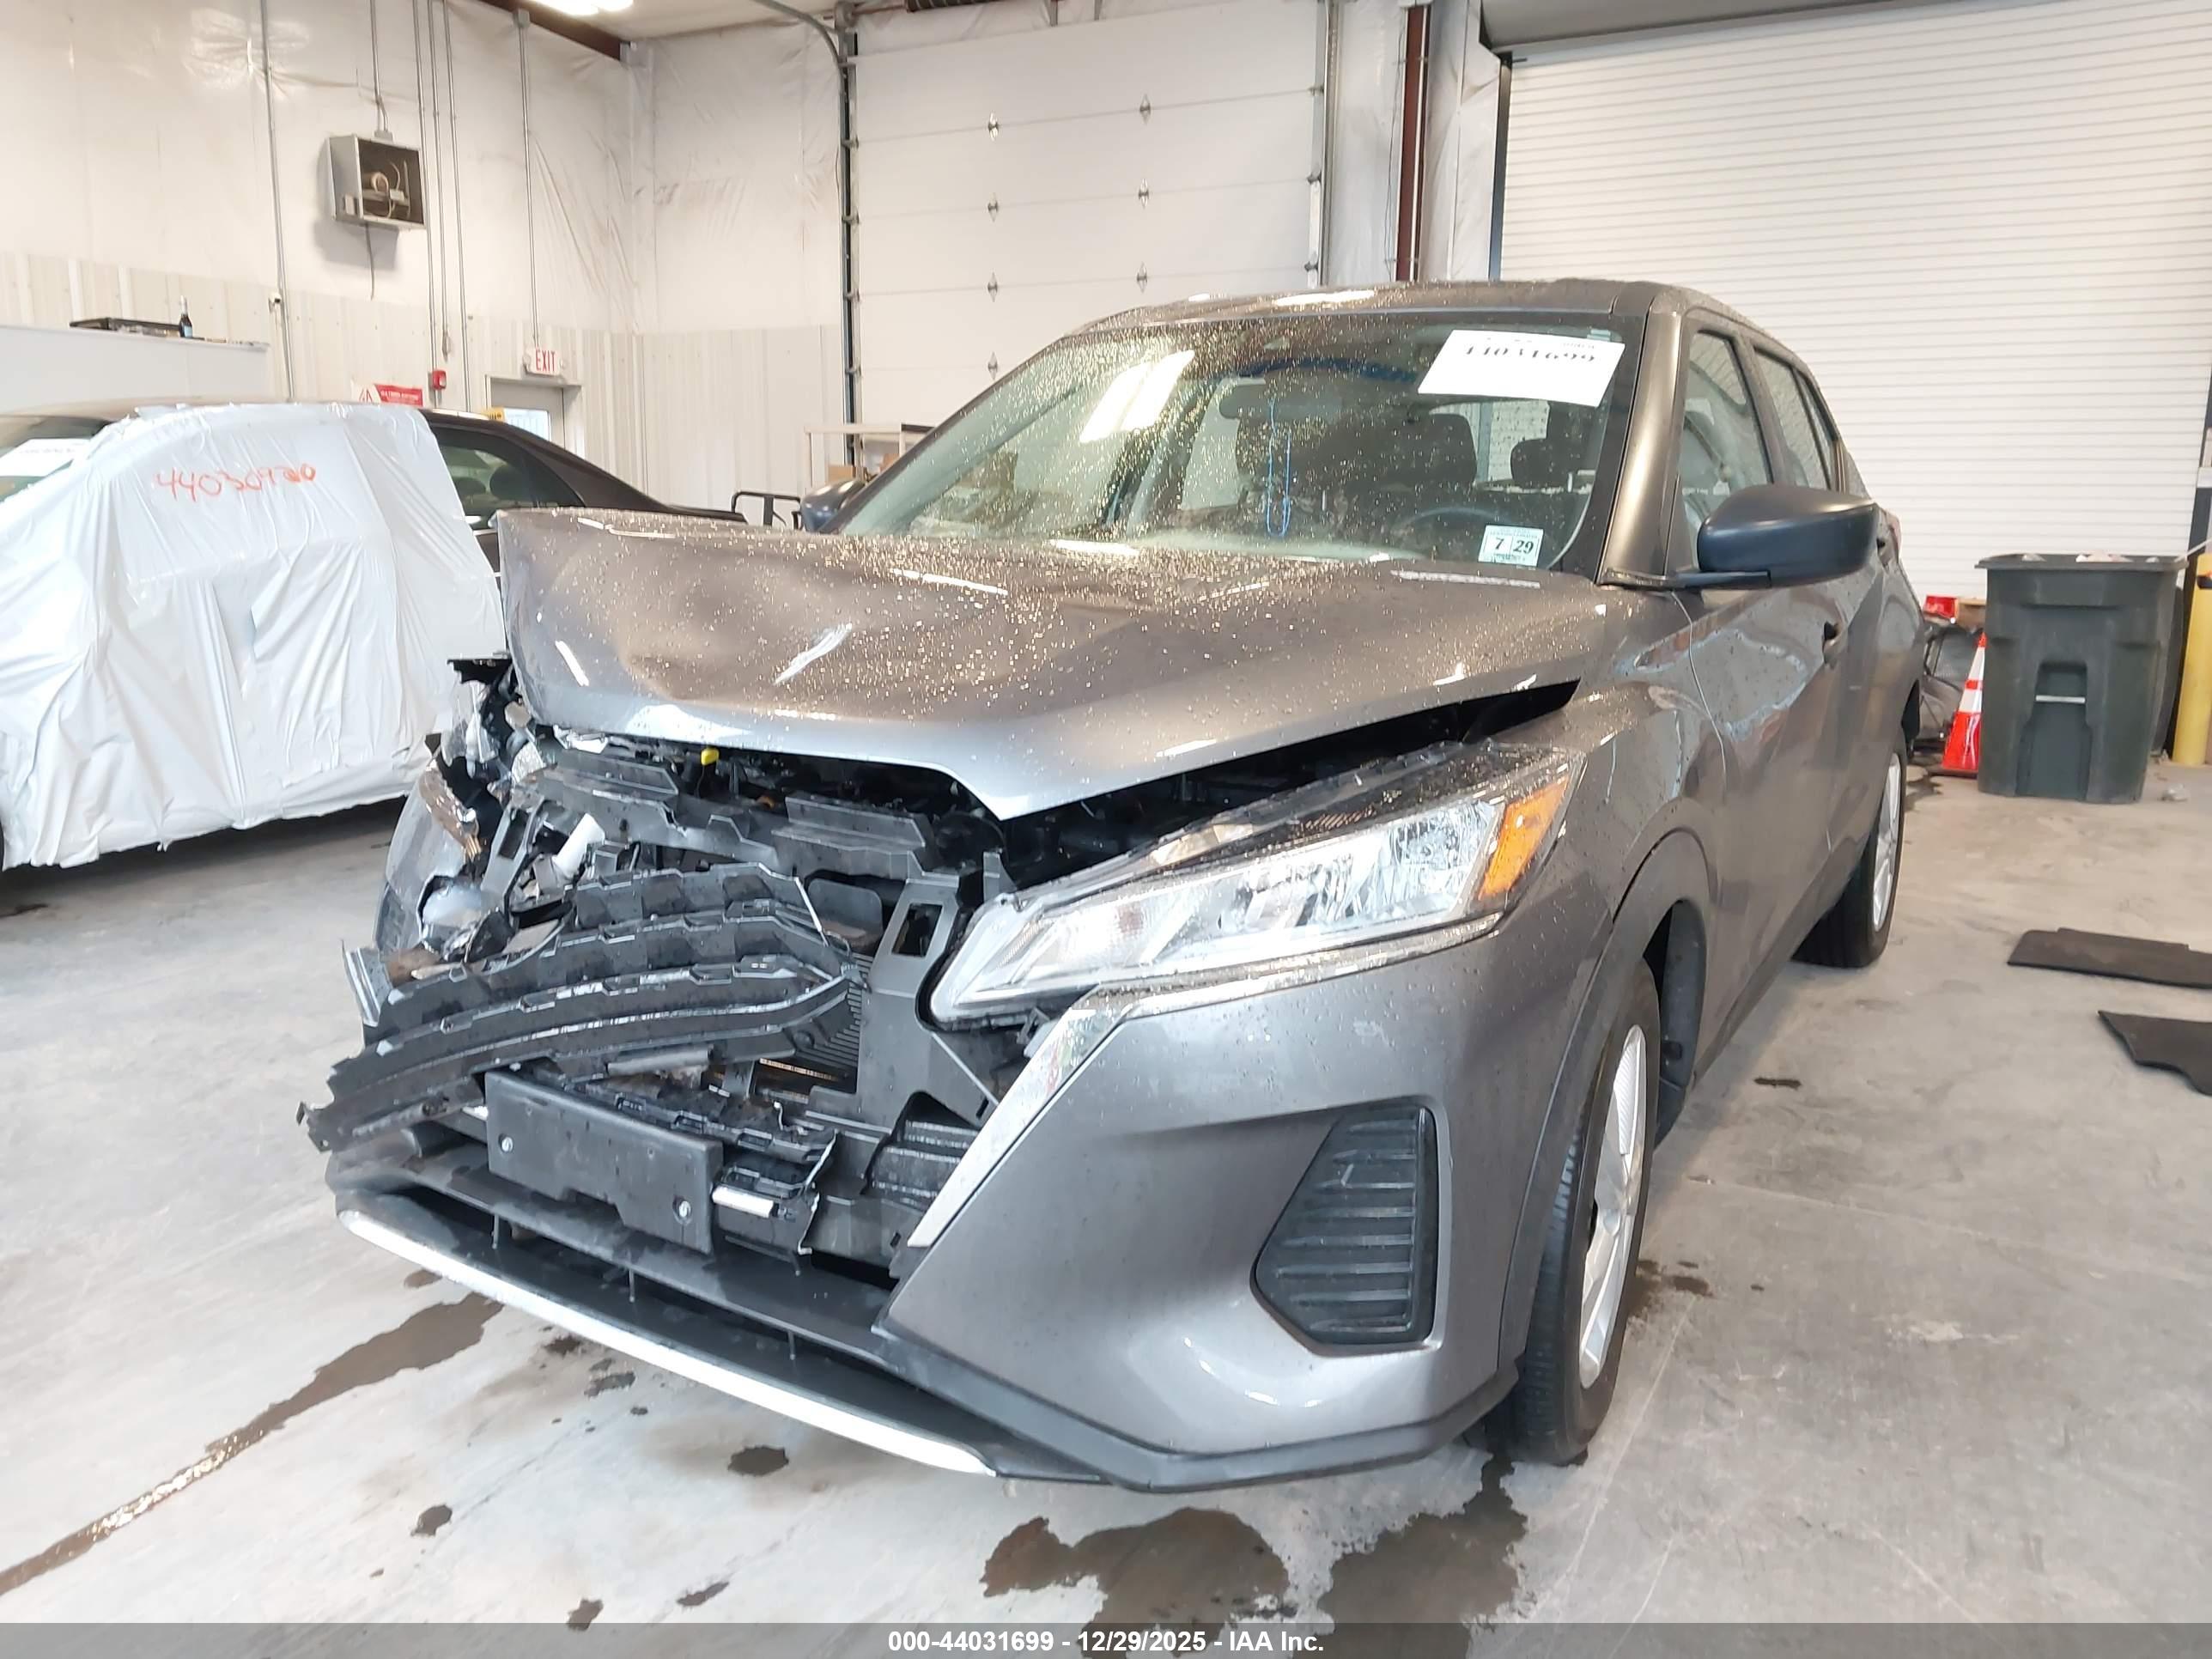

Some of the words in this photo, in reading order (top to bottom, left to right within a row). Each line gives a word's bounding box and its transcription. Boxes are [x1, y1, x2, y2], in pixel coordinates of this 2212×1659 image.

[536, 349, 556, 372] EXIT
[1495, 537, 1505, 550] 7
[1513, 540, 1534, 555] 29
